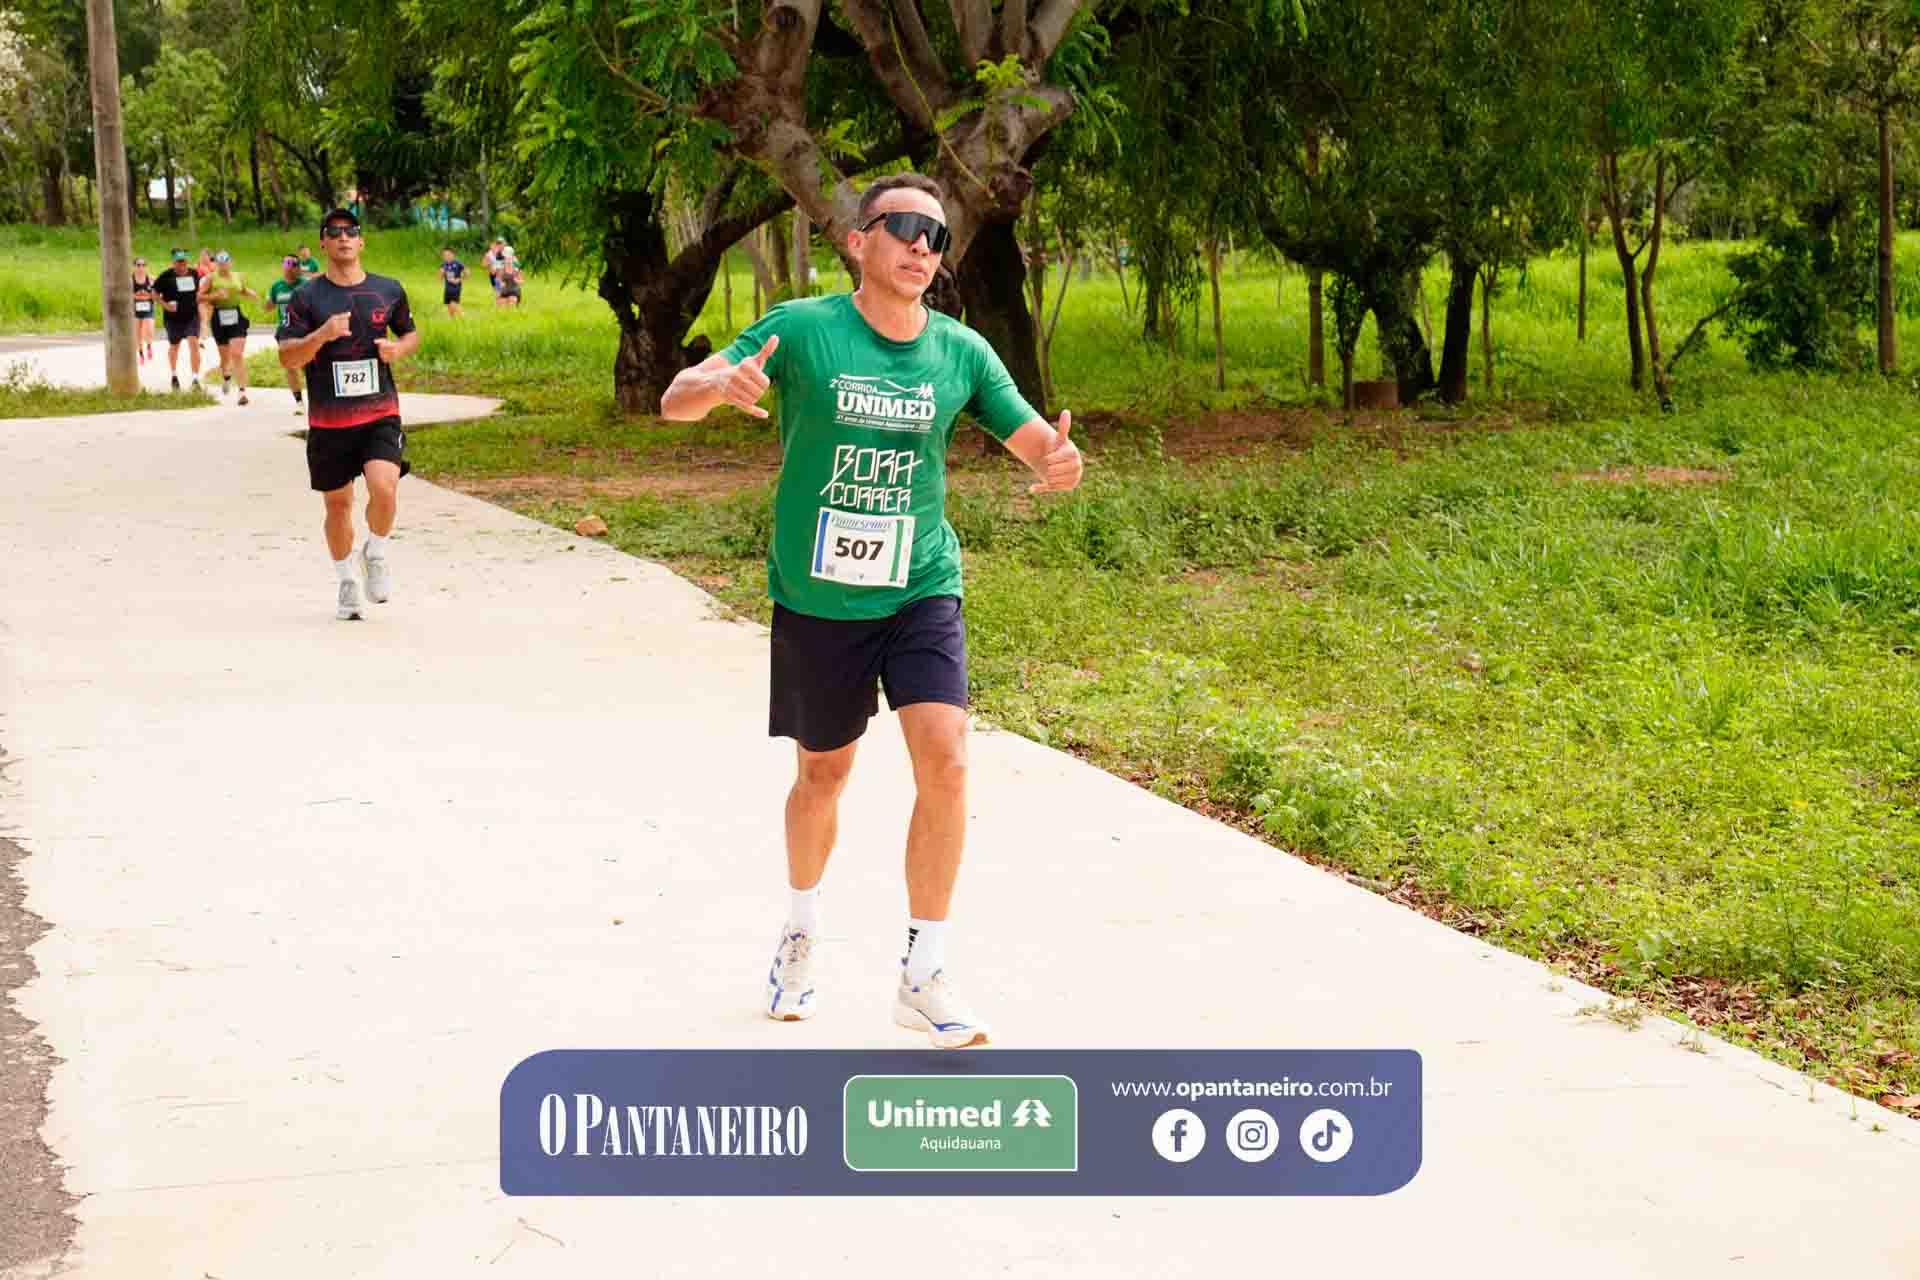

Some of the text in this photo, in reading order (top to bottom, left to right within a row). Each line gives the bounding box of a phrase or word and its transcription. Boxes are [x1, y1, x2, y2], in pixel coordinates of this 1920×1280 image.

[343, 371, 367, 385] 782
[838, 379, 879, 394] CORRIDA
[837, 390, 936, 421] UNIMED
[820, 444, 924, 496] BORA
[830, 482, 912, 513] CORRER
[834, 536, 885, 561] 507
